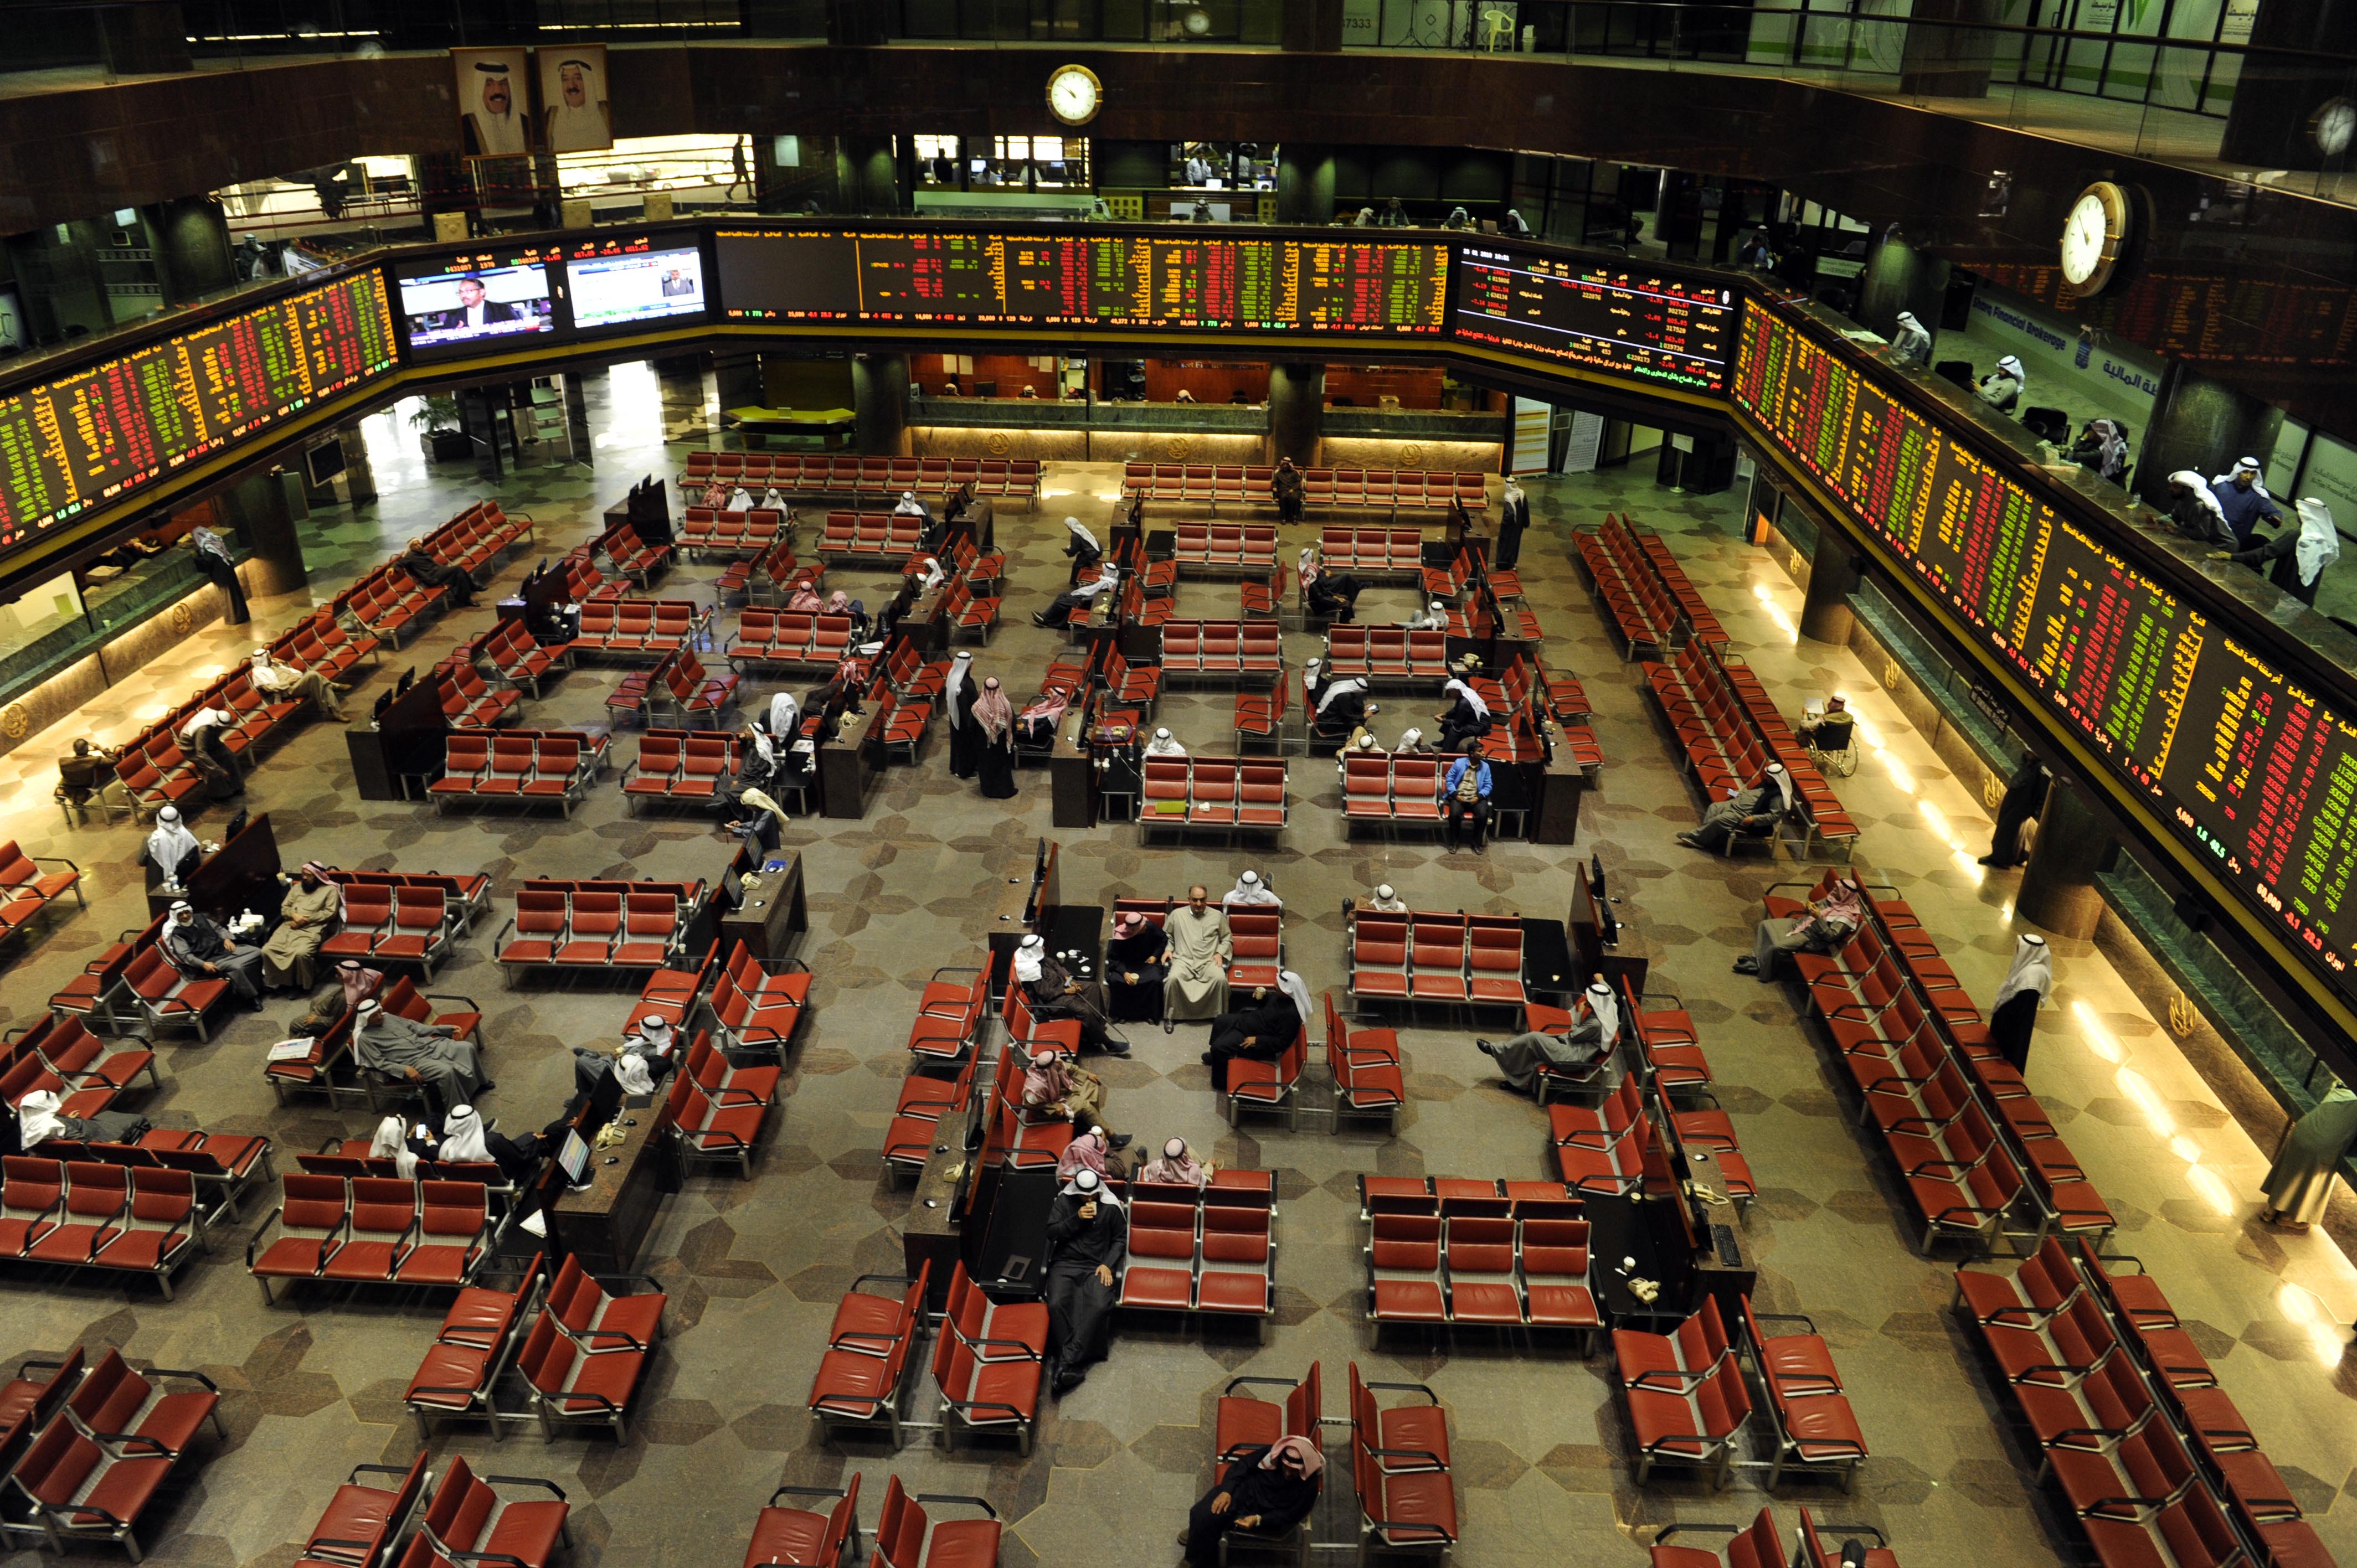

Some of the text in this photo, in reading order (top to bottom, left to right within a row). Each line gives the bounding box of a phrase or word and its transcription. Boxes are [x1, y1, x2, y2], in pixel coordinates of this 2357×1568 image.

[1972, 296, 2067, 351] Sharq Financial Brokerage
[2102, 359, 2142, 389] المالية
[2299, 788, 2307, 800] 73
[2304, 865, 2321, 883] 2500
[2301, 877, 2317, 894] 1500
[2325, 884, 2341, 901] 1012
[2257, 883, 2282, 911] 60,000
